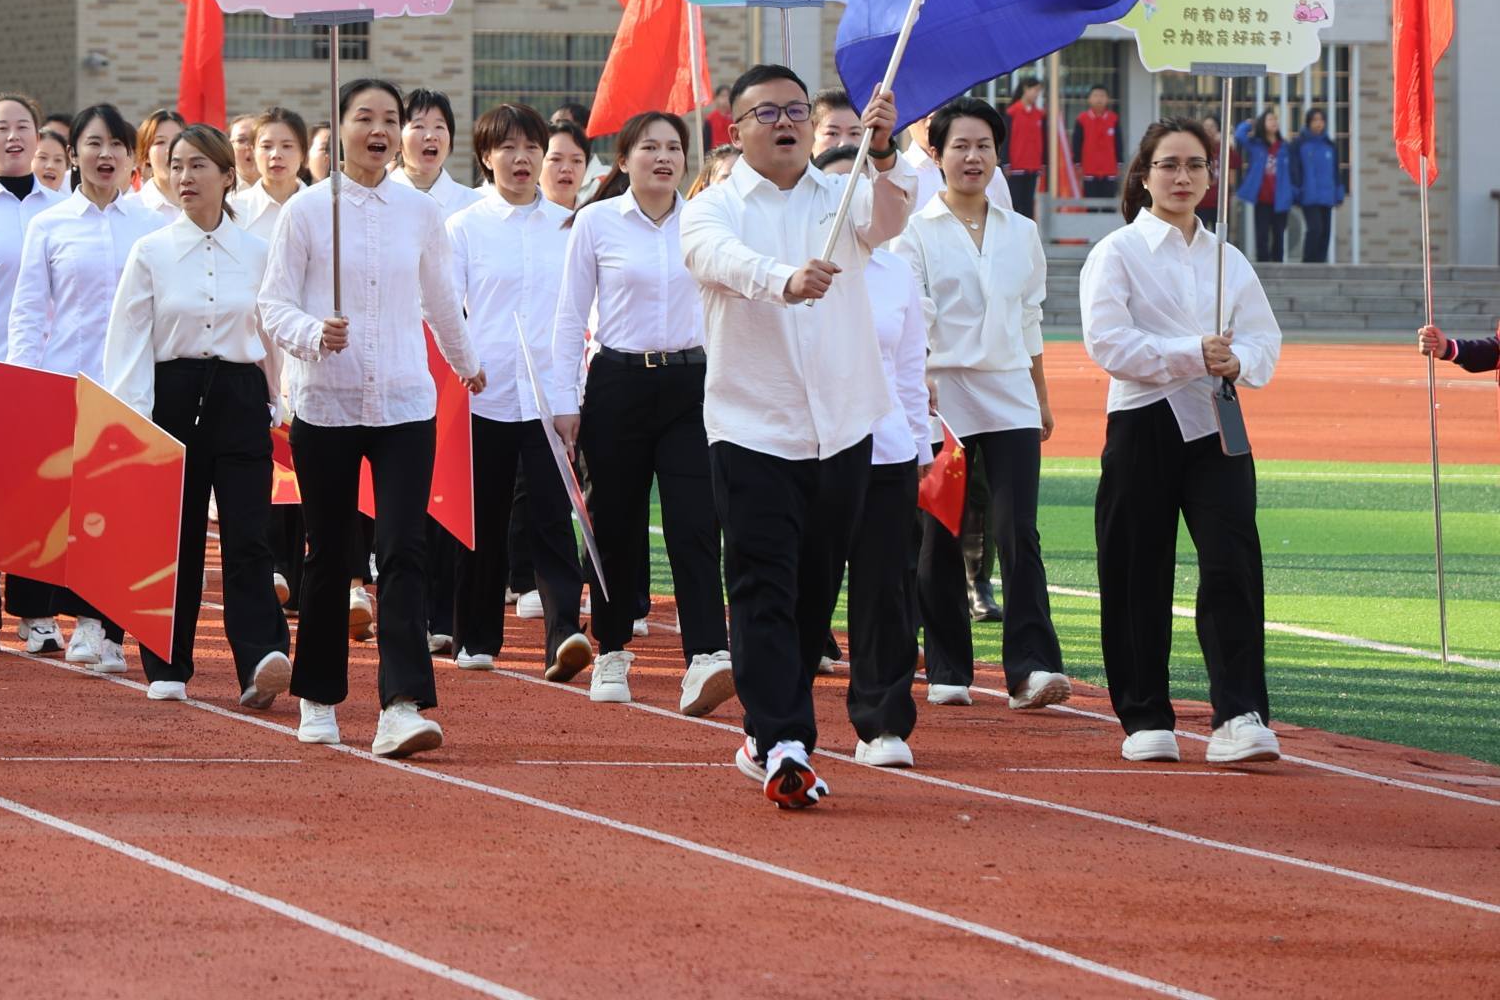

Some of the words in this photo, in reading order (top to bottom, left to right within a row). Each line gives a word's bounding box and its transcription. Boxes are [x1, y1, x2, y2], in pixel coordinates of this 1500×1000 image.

[1183, 6, 1269, 23] 所有的努力
[1162, 28, 1293, 46] 只为教育好孩子！
